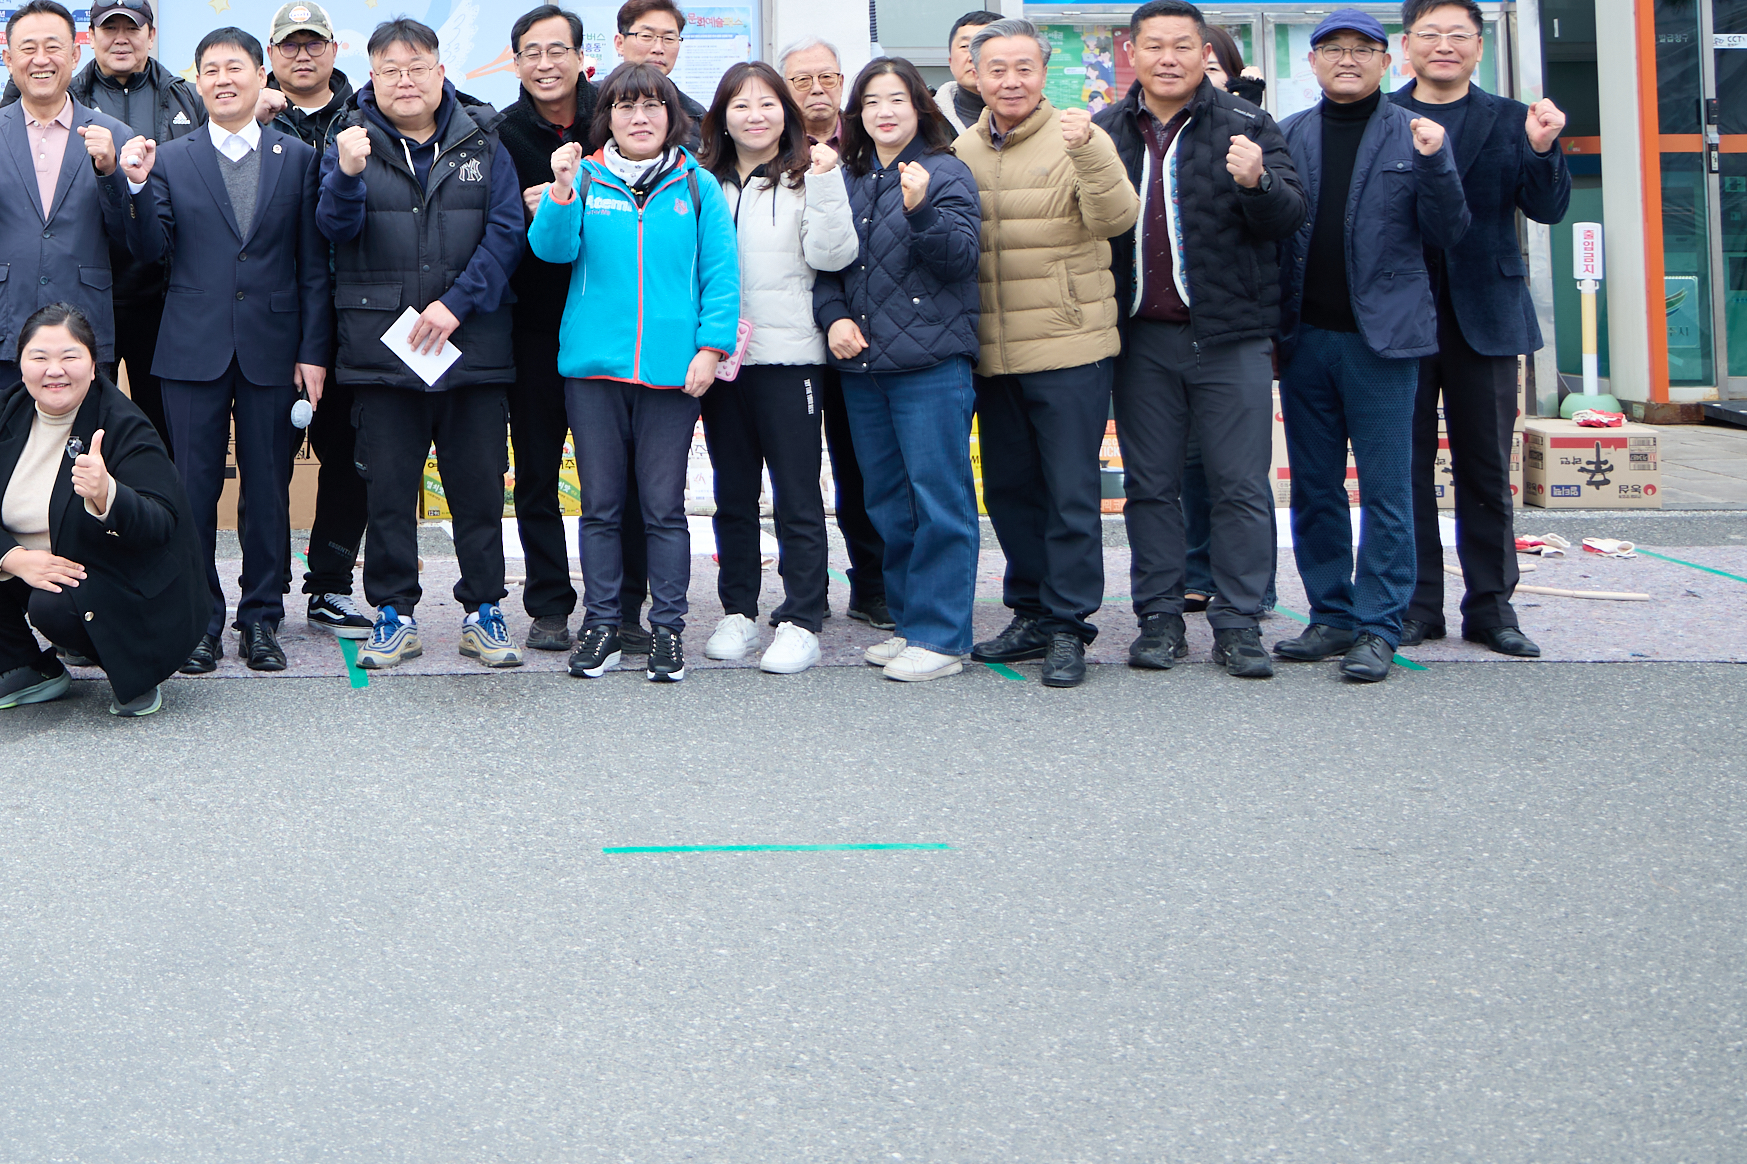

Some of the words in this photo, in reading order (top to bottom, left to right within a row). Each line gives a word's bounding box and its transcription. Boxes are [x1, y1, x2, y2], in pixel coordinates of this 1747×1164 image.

[1582, 229, 1595, 274] 출입금지
[1667, 325, 1689, 337] 주시
[1577, 440, 1614, 491] 辛
